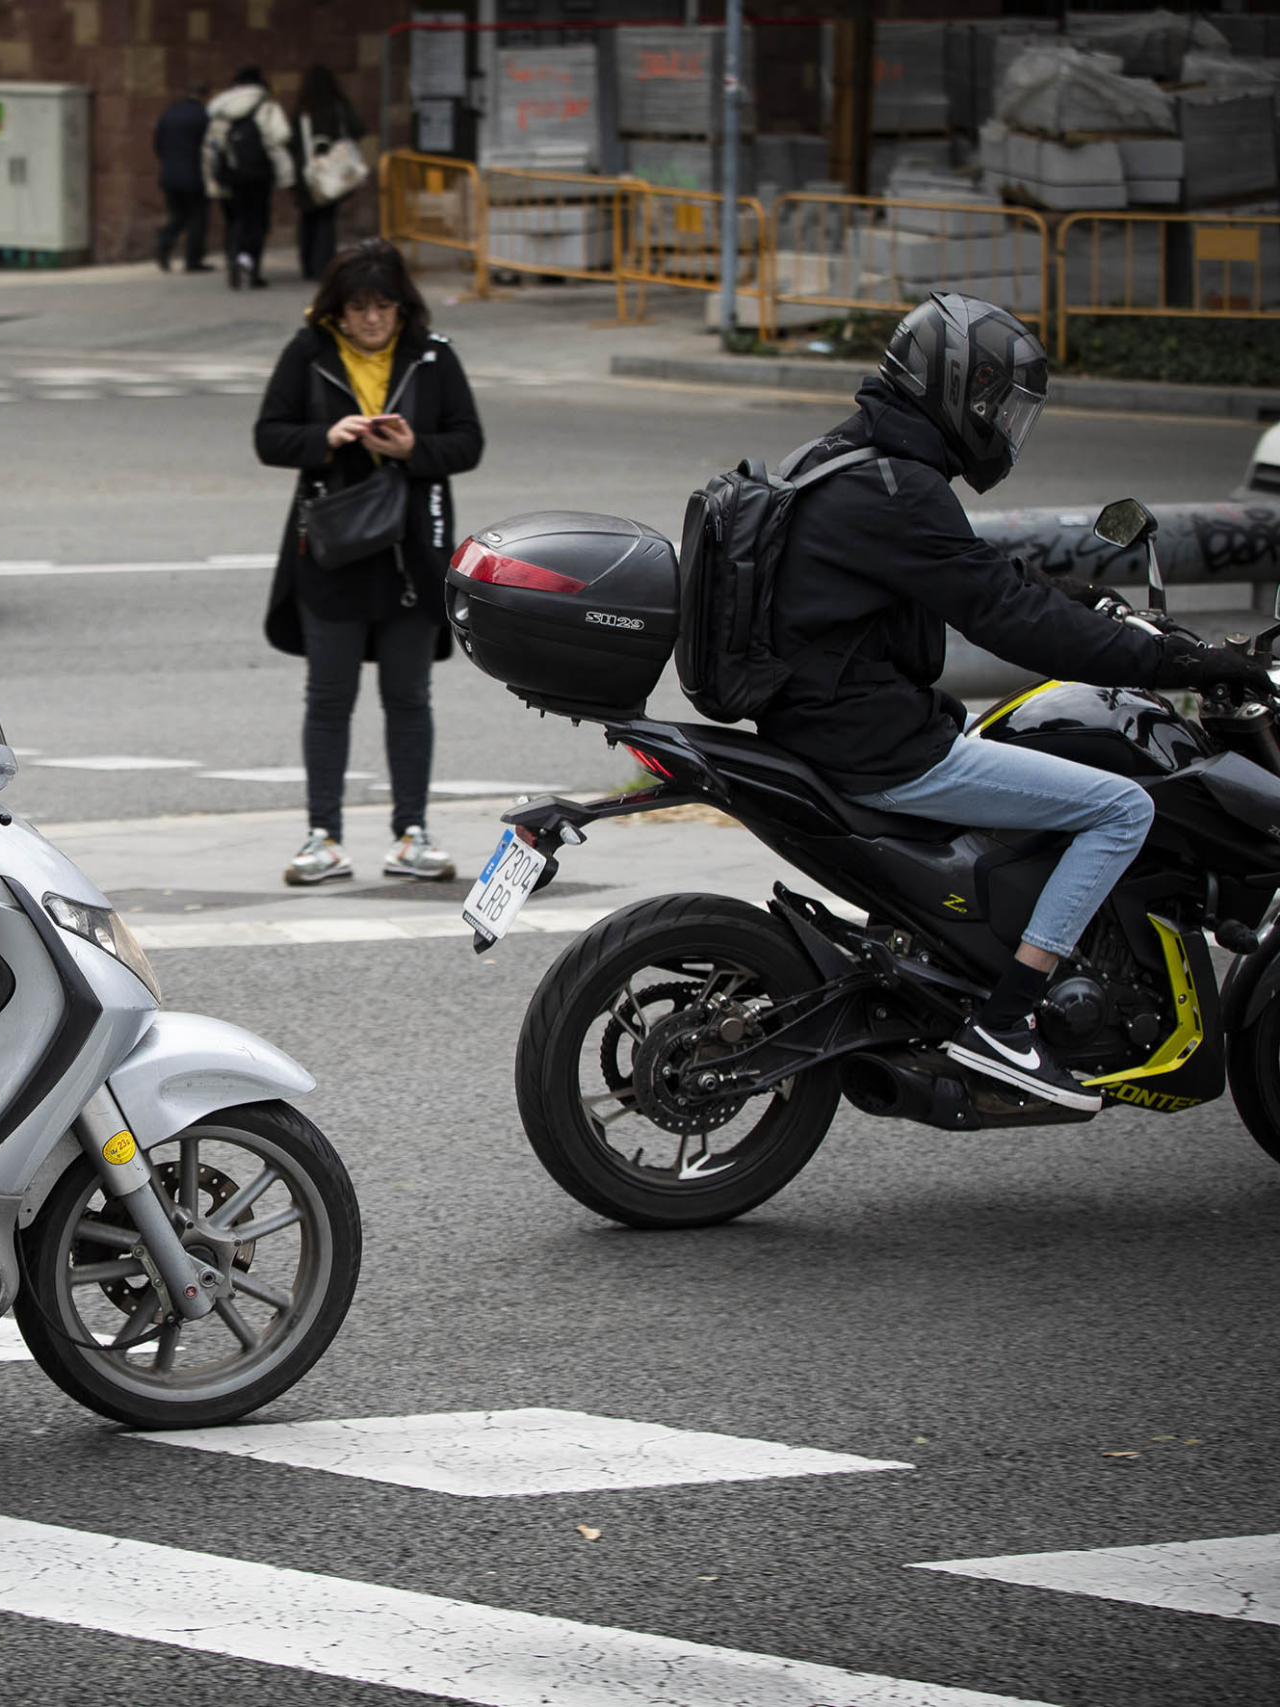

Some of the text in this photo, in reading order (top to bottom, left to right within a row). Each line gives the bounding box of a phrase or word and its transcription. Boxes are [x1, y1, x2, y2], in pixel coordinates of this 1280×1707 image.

[585, 611, 645, 630] SH29
[497, 842, 539, 895] 7304
[476, 877, 511, 922] LRB
